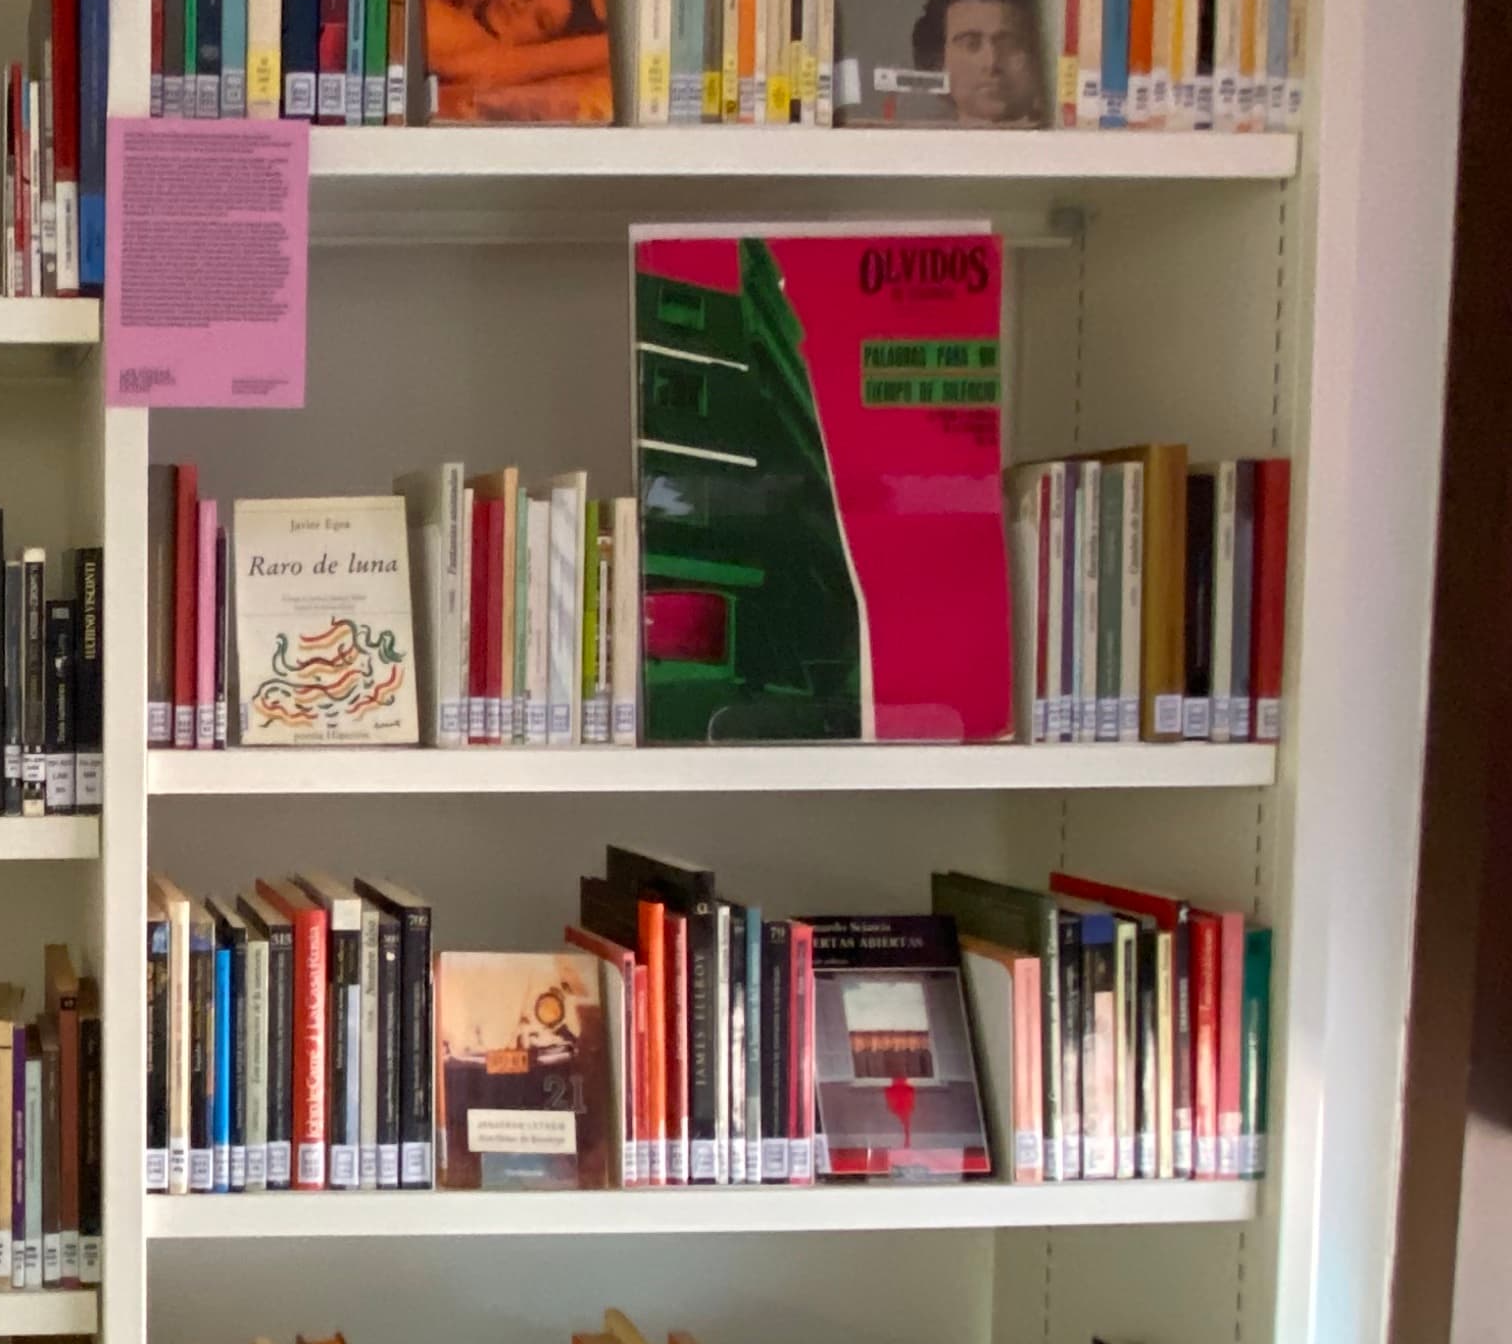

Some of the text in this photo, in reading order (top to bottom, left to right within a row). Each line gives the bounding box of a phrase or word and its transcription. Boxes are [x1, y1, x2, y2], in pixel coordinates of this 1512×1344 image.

[860, 247, 989, 293] OLVIDOS
[248, 552, 399, 577] Raro de luna
[813, 936, 924, 948] ERTAS ABIERTAS
[694, 953, 707, 1086] JAMES ELLROY
[543, 1073, 587, 1114] 21
